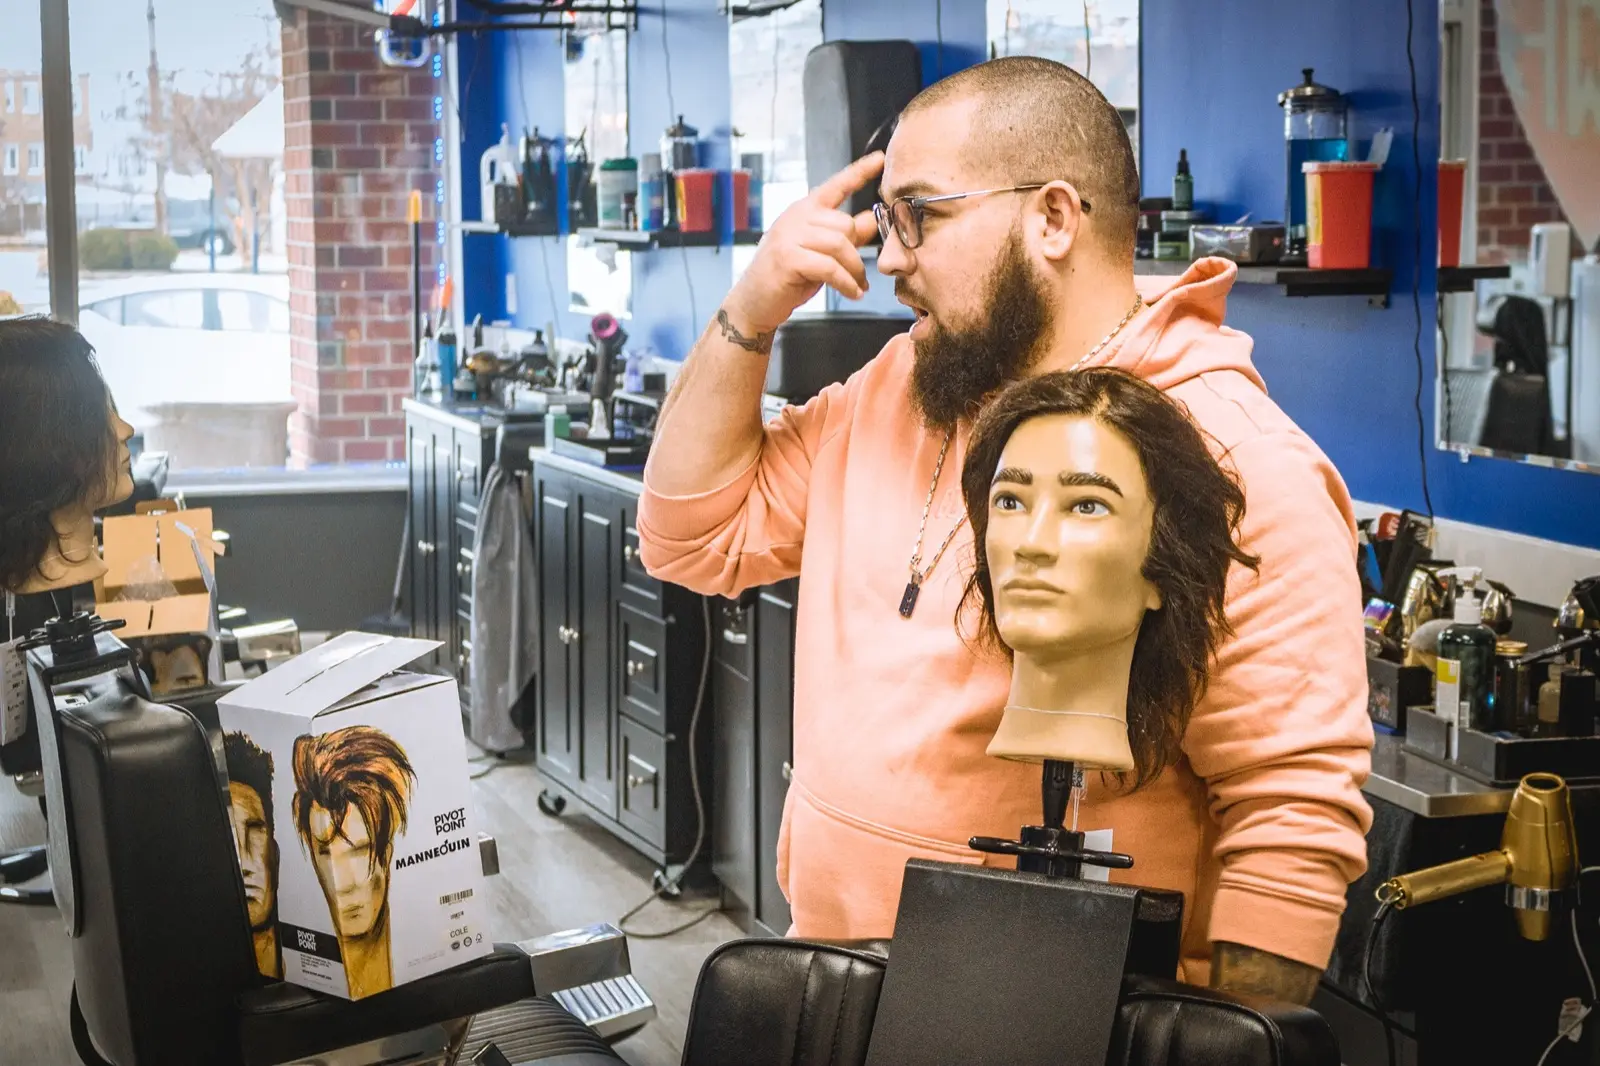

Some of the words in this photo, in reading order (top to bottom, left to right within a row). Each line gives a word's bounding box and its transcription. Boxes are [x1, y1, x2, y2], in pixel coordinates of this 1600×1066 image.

[434, 807, 465, 826] PIVOT
[435, 817, 466, 836] POINT
[296, 929, 316, 942] PIVOT
[449, 925, 468, 938] COLE
[298, 938, 317, 951] POINT
